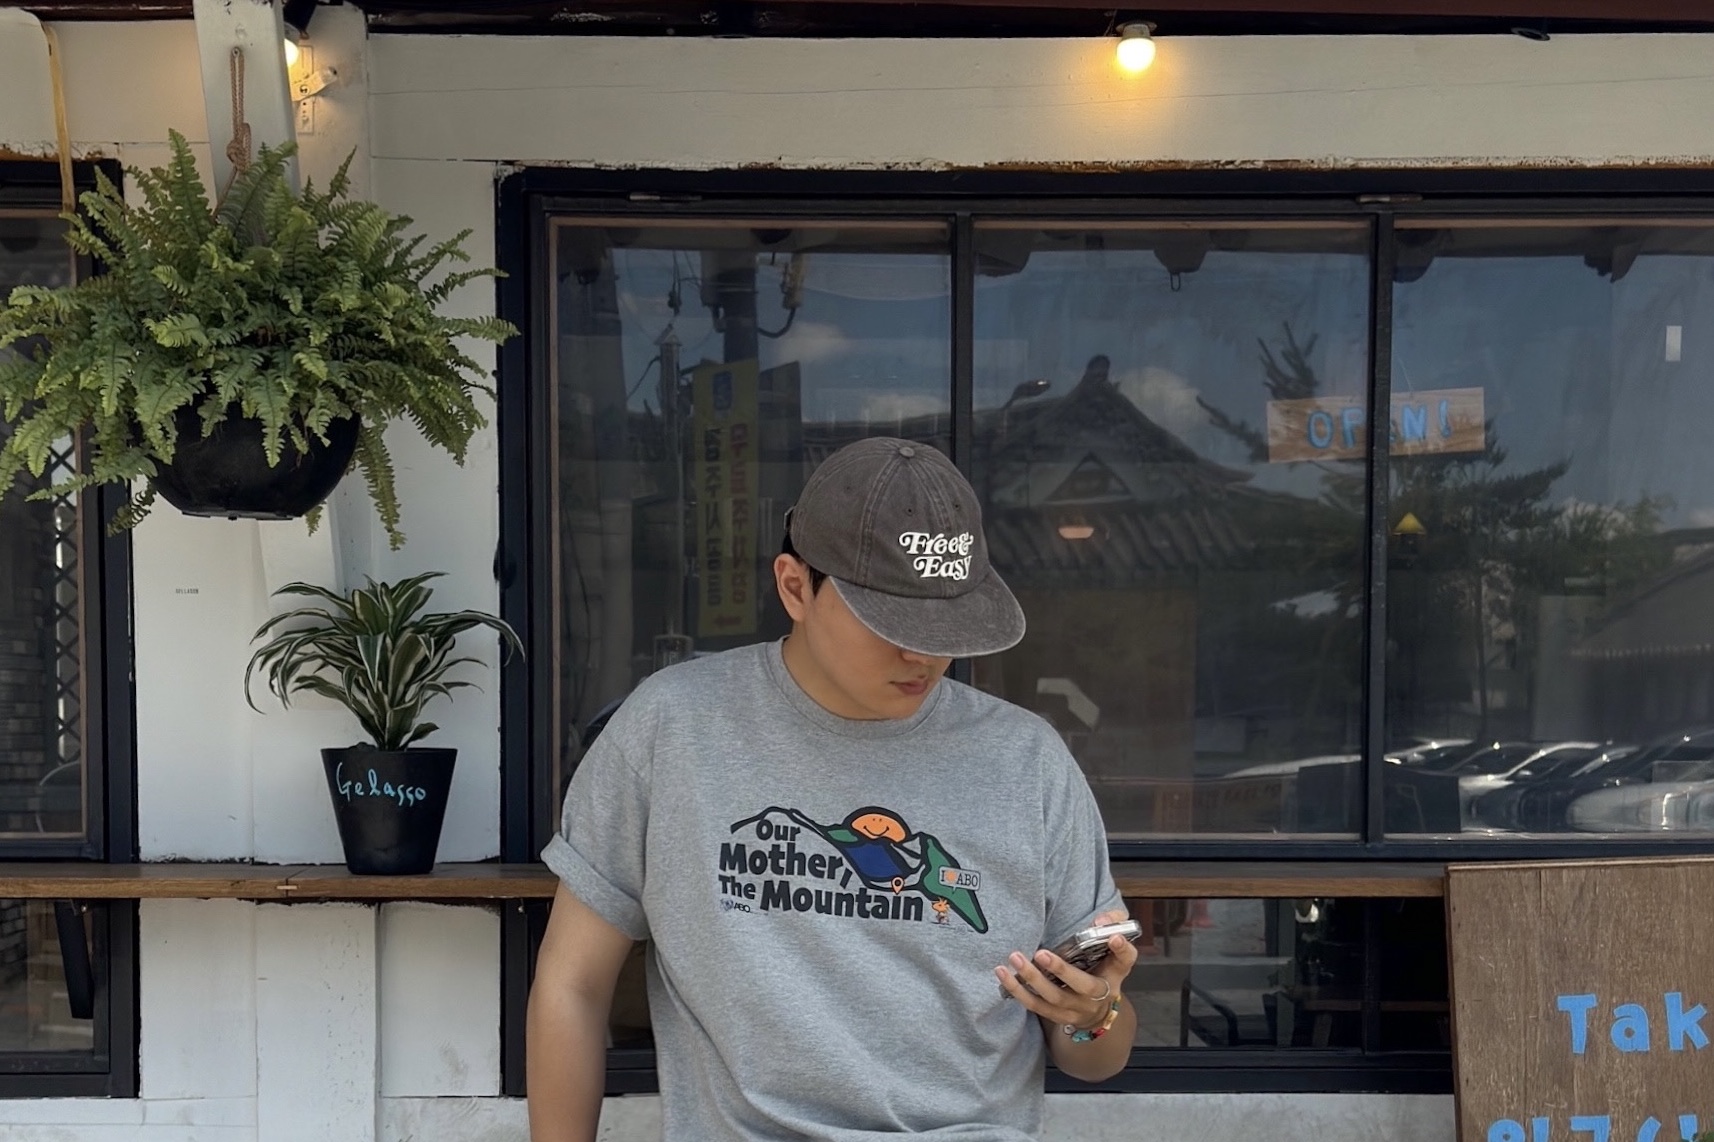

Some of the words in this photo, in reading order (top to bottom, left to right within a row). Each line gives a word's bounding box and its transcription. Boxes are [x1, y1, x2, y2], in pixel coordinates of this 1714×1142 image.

[1307, 400, 1452, 449] OPN!
[913, 555, 972, 580] Easy
[756, 819, 800, 841] Our
[719, 843, 853, 889] Mother,
[956, 873, 978, 887] ABO
[718, 875, 756, 899] The
[760, 880, 923, 922] Mountain
[1557, 992, 1710, 1054] Tak
